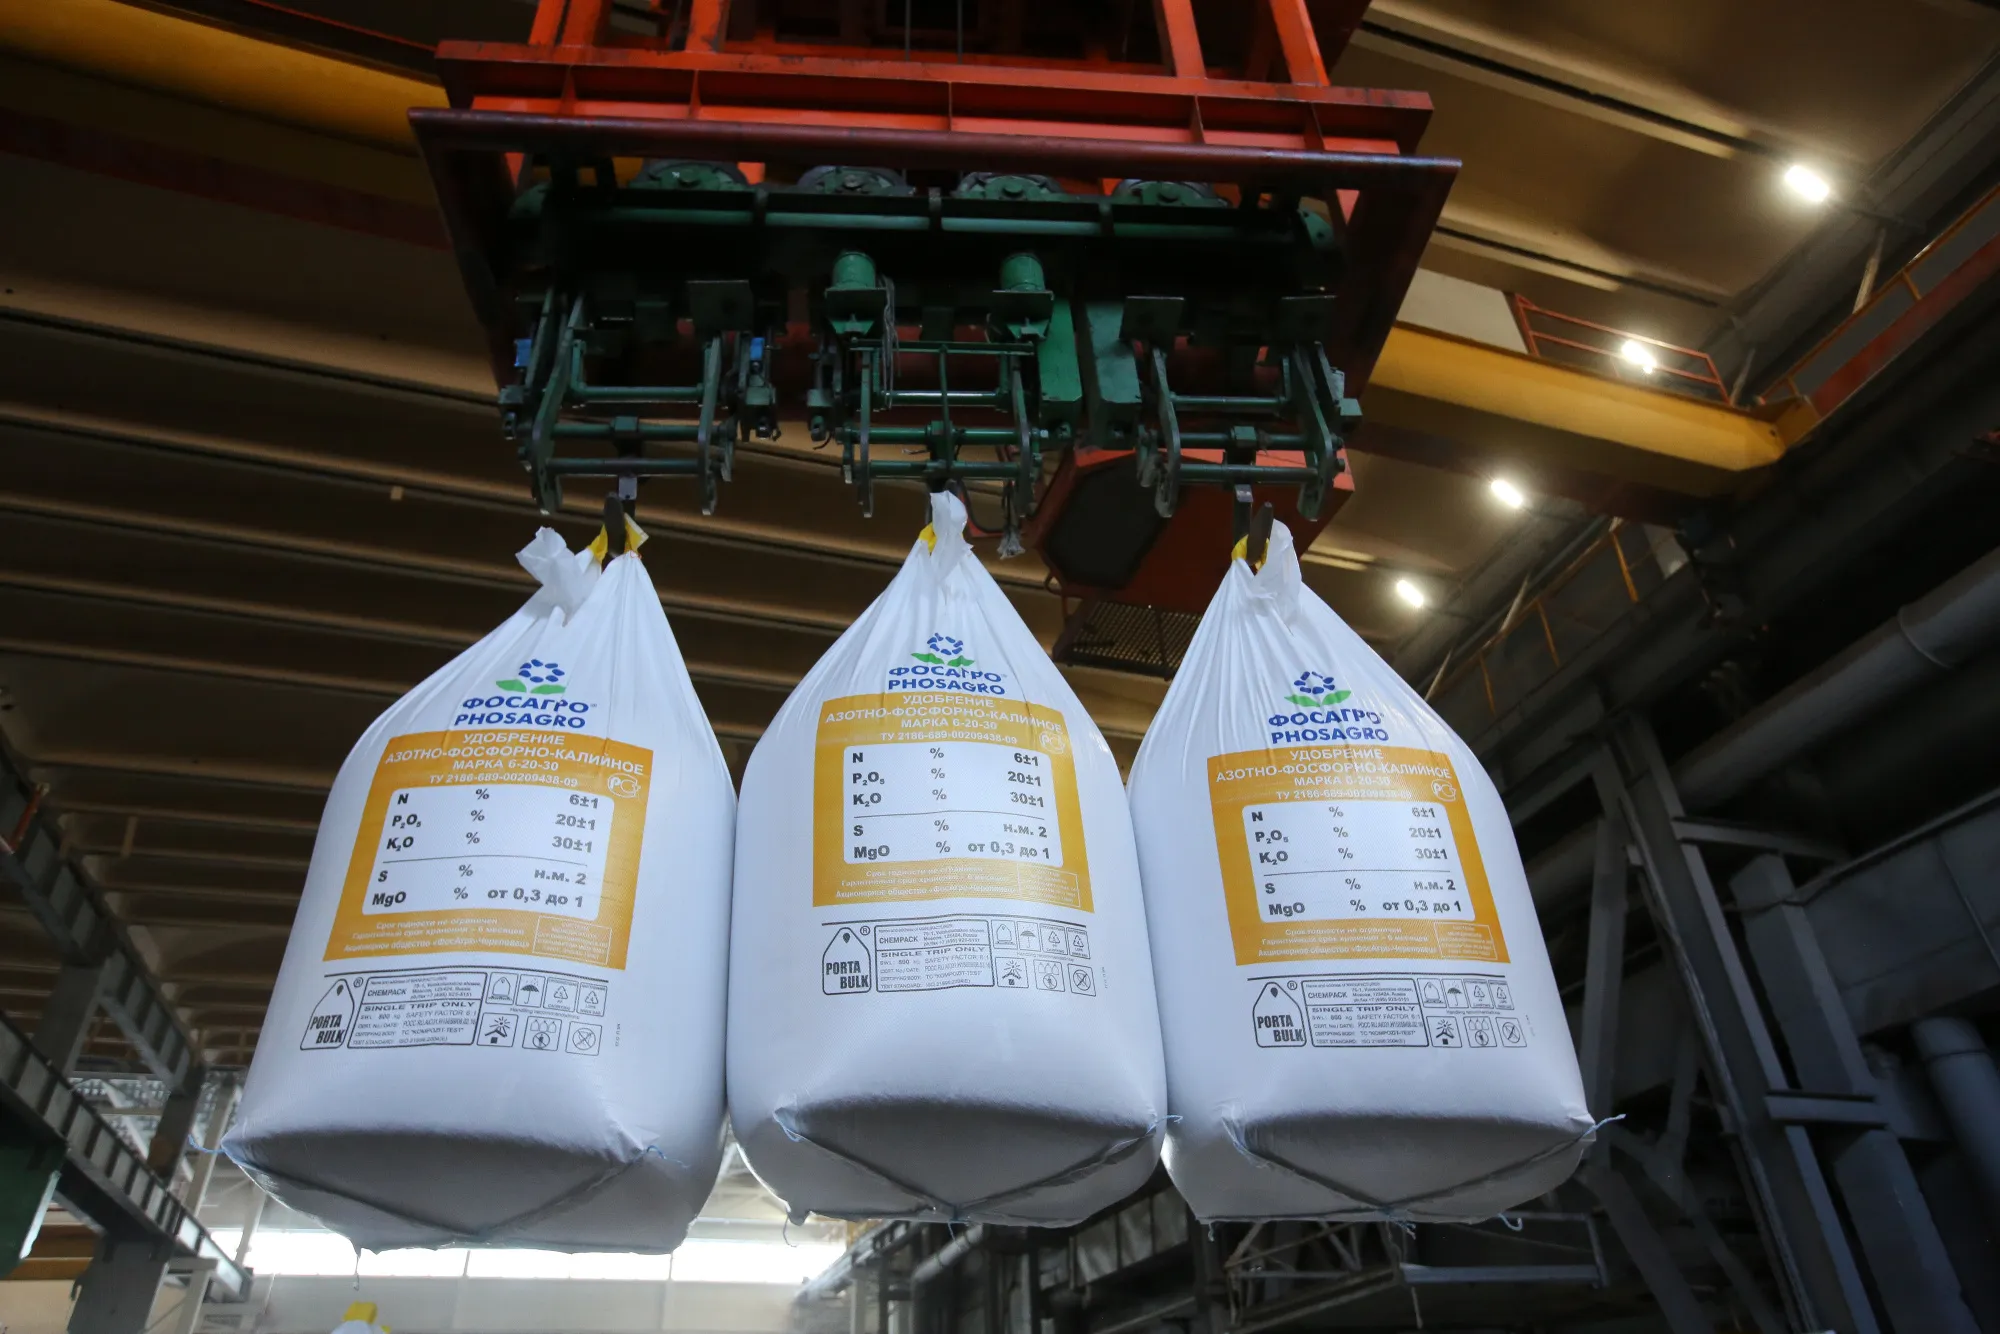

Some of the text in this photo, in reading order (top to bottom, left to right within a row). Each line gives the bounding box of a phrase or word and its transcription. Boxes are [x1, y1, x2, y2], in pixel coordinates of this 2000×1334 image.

[888, 665, 1002, 683] ФОСАГРО
[888, 679, 1005, 695] PHOSAGRO
[462, 696, 589, 713] ФОСАГРО
[903, 694, 994, 708] УДОБРЕНИЕ
[454, 712, 585, 728] PHOSAGRO
[901, 718, 997, 730] МАРКА 6-20-30
[1268, 709, 1382, 727] ФОСАГРО
[463, 732, 565, 745] УДОБРЕНИЕ
[880, 732, 895, 741] ТУ
[1271, 727, 1389, 744] PHOSAGRO
[385, 745, 644, 776] АЗОТНО-ФОСФОРНО-КАЛИЙНОЕ
[852, 747, 1039, 767] N % 6±1
[1290, 749, 1384, 761] УДОБРЕНИЕ
[453, 759, 558, 771] МАРКА 6-20-30
[1216, 762, 1452, 783] АЗОТНО-ФОСФОРНО-КАЛИЙНОЕ
[430, 775, 444, 783] ТУ
[931, 768, 945, 779] %
[1007, 771, 1042, 787] 20±1
[1294, 776, 1341, 786] МАРКА
[397, 788, 598, 809] N % 6±1
[932, 788, 947, 800] %
[1010, 792, 1044, 808] 30±1
[1276, 791, 1290, 800] ТУ
[471, 810, 485, 821] %
[555, 814, 596, 830] 20±1
[1251, 806, 1435, 822] N % 6±1
[853, 825, 863, 836] S
[934, 819, 949, 832] %
[1038, 826, 1047, 838] 2
[1333, 827, 1349, 838] %
[1409, 827, 1442, 838] 20±1
[466, 832, 480, 843] %
[552, 836, 592, 853] 30±1
[854, 841, 1050, 860] MgO % от 0,3 до 1
[1338, 848, 1353, 859] %
[1415, 848, 1447, 859] 30±1
[378, 870, 388, 882] S
[459, 864, 473, 877] %
[575, 873, 586, 885] 2
[1265, 883, 1276, 894] S
[1345, 878, 1361, 890] %
[1447, 880, 1456, 890] 2
[372, 887, 583, 908] MgO % от 0,3 до 1
[1269, 900, 1462, 917] MgO % от 0,3 до 1
[879, 936, 918, 944] CHEMPACK
[826, 961, 861, 975] PORTA
[840, 975, 869, 989] BULK
[364, 1003, 405, 1012] SINGLE
[411, 1002, 437, 1010] TRIP
[310, 1014, 342, 1029] PORTA
[1257, 1015, 1293, 1028] PORTA
[316, 1030, 345, 1044] BULK
[1273, 1029, 1304, 1042] BULK
